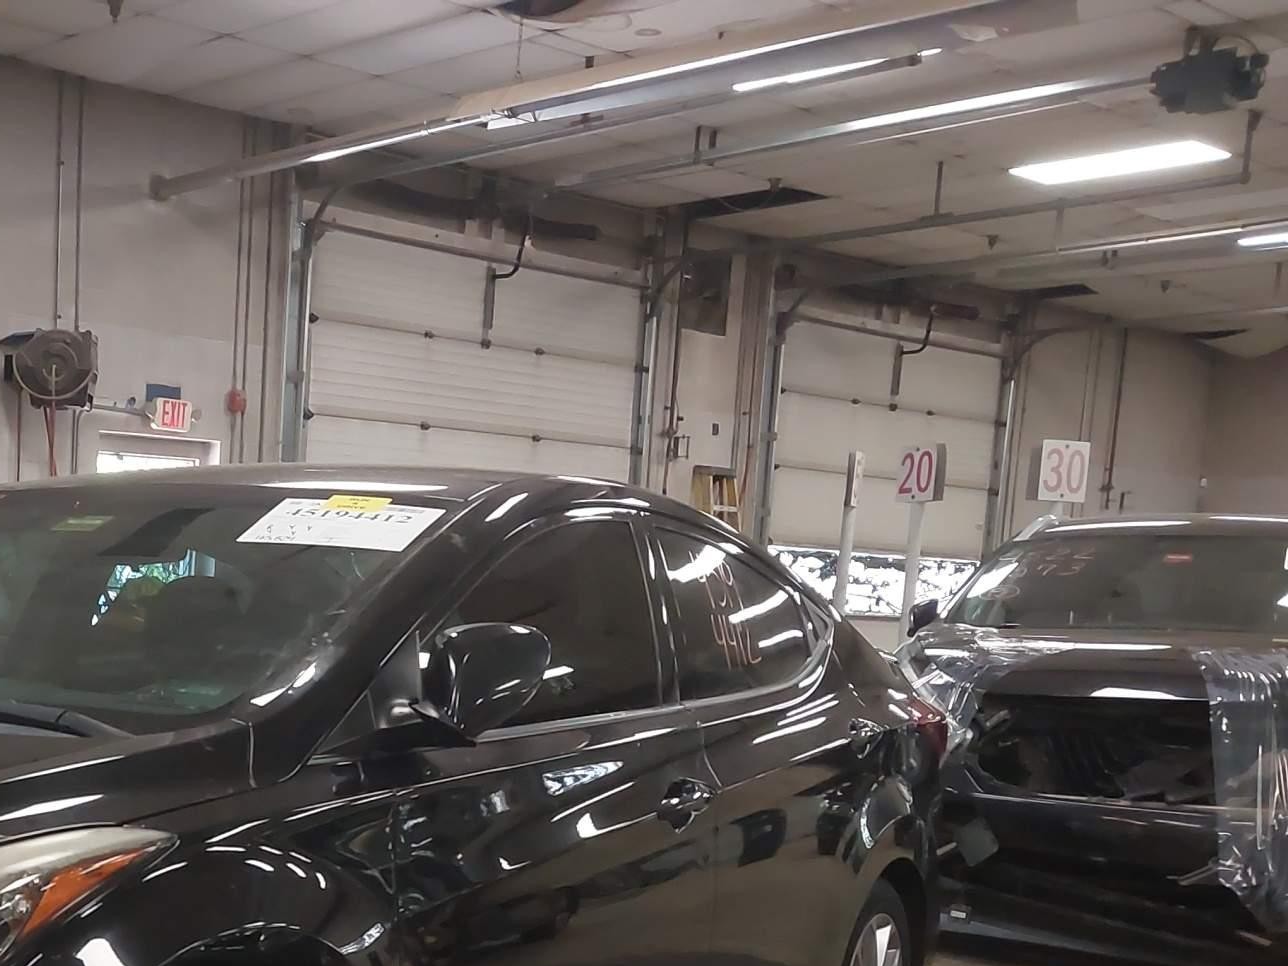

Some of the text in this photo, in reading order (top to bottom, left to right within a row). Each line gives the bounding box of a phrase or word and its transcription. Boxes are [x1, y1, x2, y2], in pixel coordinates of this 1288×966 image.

[162, 399, 187, 427] EXIT
[898, 450, 933, 494] 20
[1043, 447, 1086, 494] 30
